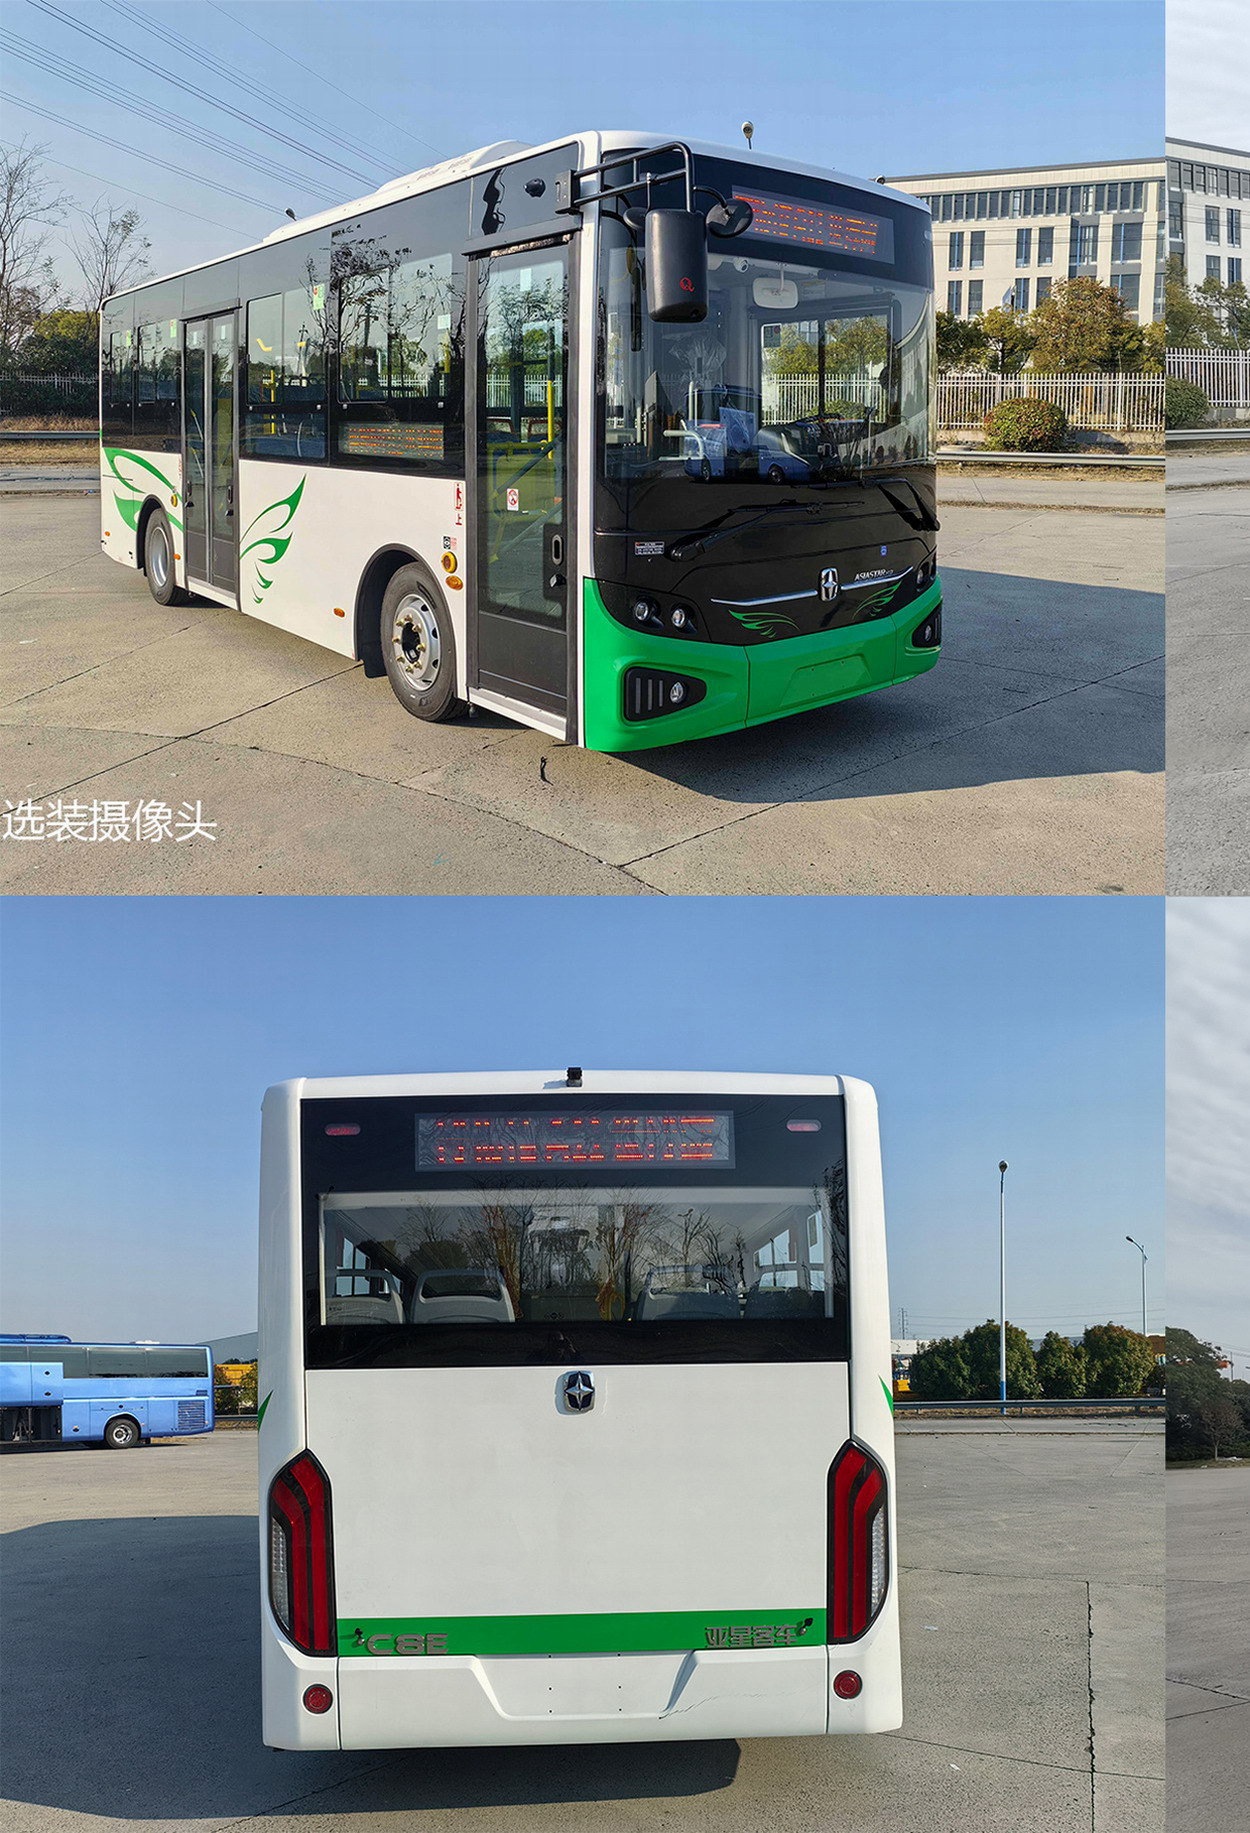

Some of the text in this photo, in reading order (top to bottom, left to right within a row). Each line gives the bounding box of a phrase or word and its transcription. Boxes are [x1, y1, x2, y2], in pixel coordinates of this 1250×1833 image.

[367, 1633, 449, 1655] C8E
[705, 1625, 798, 1648] 亚星客车
